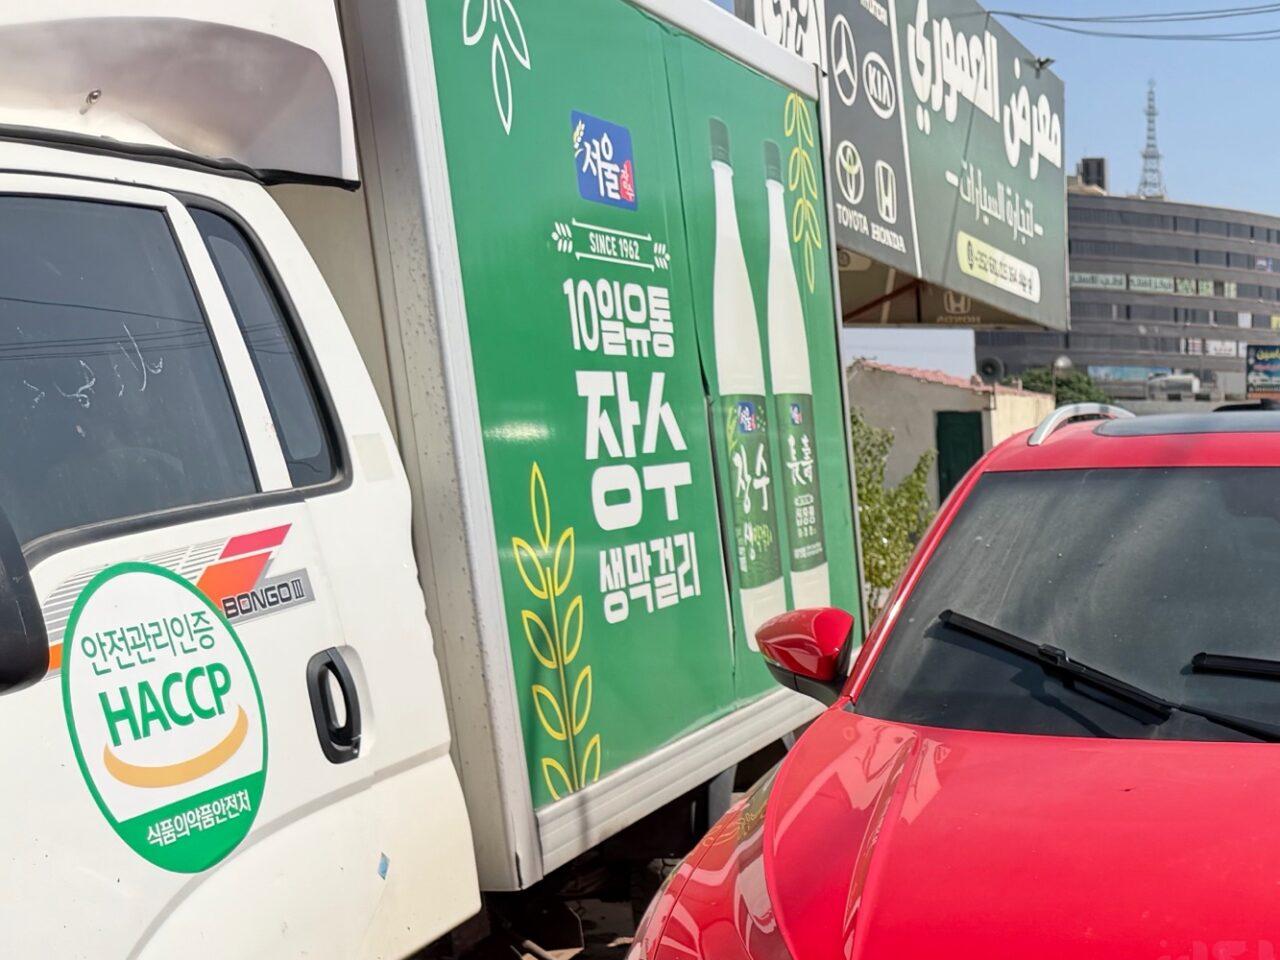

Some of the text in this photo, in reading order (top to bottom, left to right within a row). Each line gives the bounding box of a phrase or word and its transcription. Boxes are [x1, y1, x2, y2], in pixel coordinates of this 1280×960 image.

[868, 65, 891, 107] KIA
[907, 0, 1000, 135] العموري
[1003, 57, 1061, 180] معرض
[581, 133, 620, 200] 서울
[589, 232, 640, 260] SINCE 1962
[836, 203, 869, 236] TOYOTA
[871, 222, 906, 252] HONDA
[563, 278, 675, 358] 10일유통
[576, 371, 692, 531] 장수
[733, 444, 770, 514] 장수
[223, 585, 291, 618] BONGO
[600, 531, 701, 624] 생막걸리
[80, 609, 216, 676] 안전관리인증
[98, 662, 232, 747] HACCP
[147, 789, 252, 847] 식품의약품안전처
